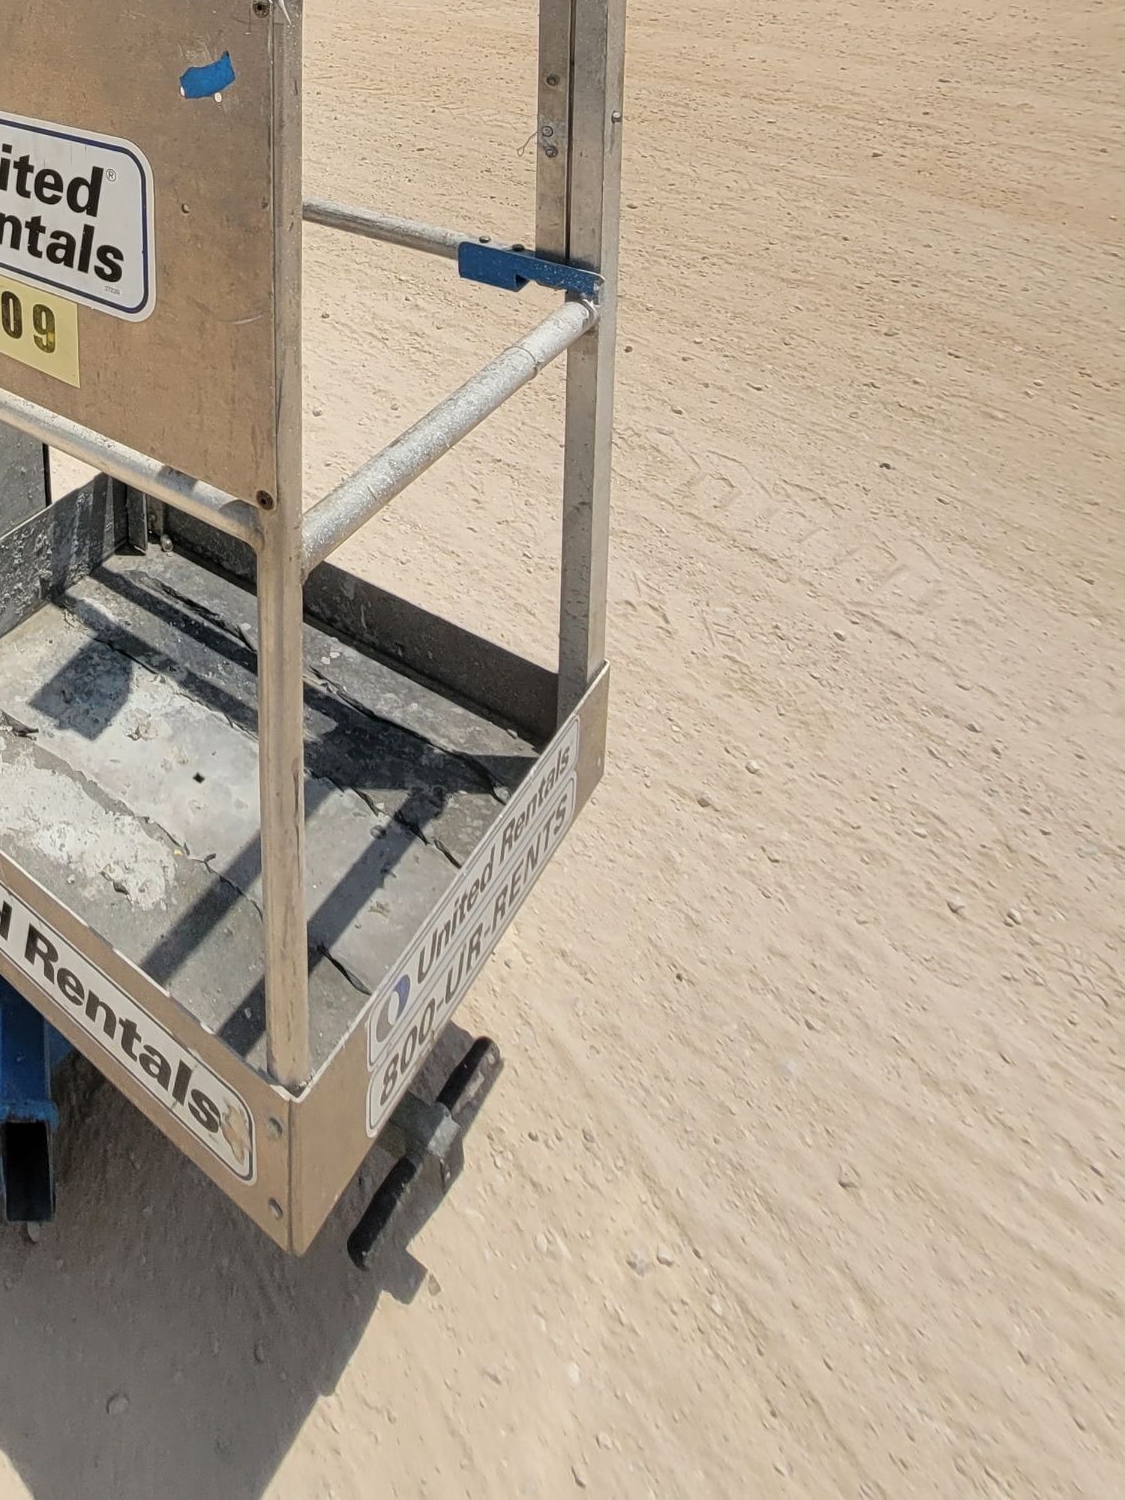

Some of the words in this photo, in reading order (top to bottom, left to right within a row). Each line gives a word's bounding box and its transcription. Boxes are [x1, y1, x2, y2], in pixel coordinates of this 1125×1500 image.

[380, 793, 568, 1106] 800-UR-RENTS
[417, 843, 496, 984] United
[499, 746, 570, 864] Rentals
[24, 924, 221, 1134] Rentals
